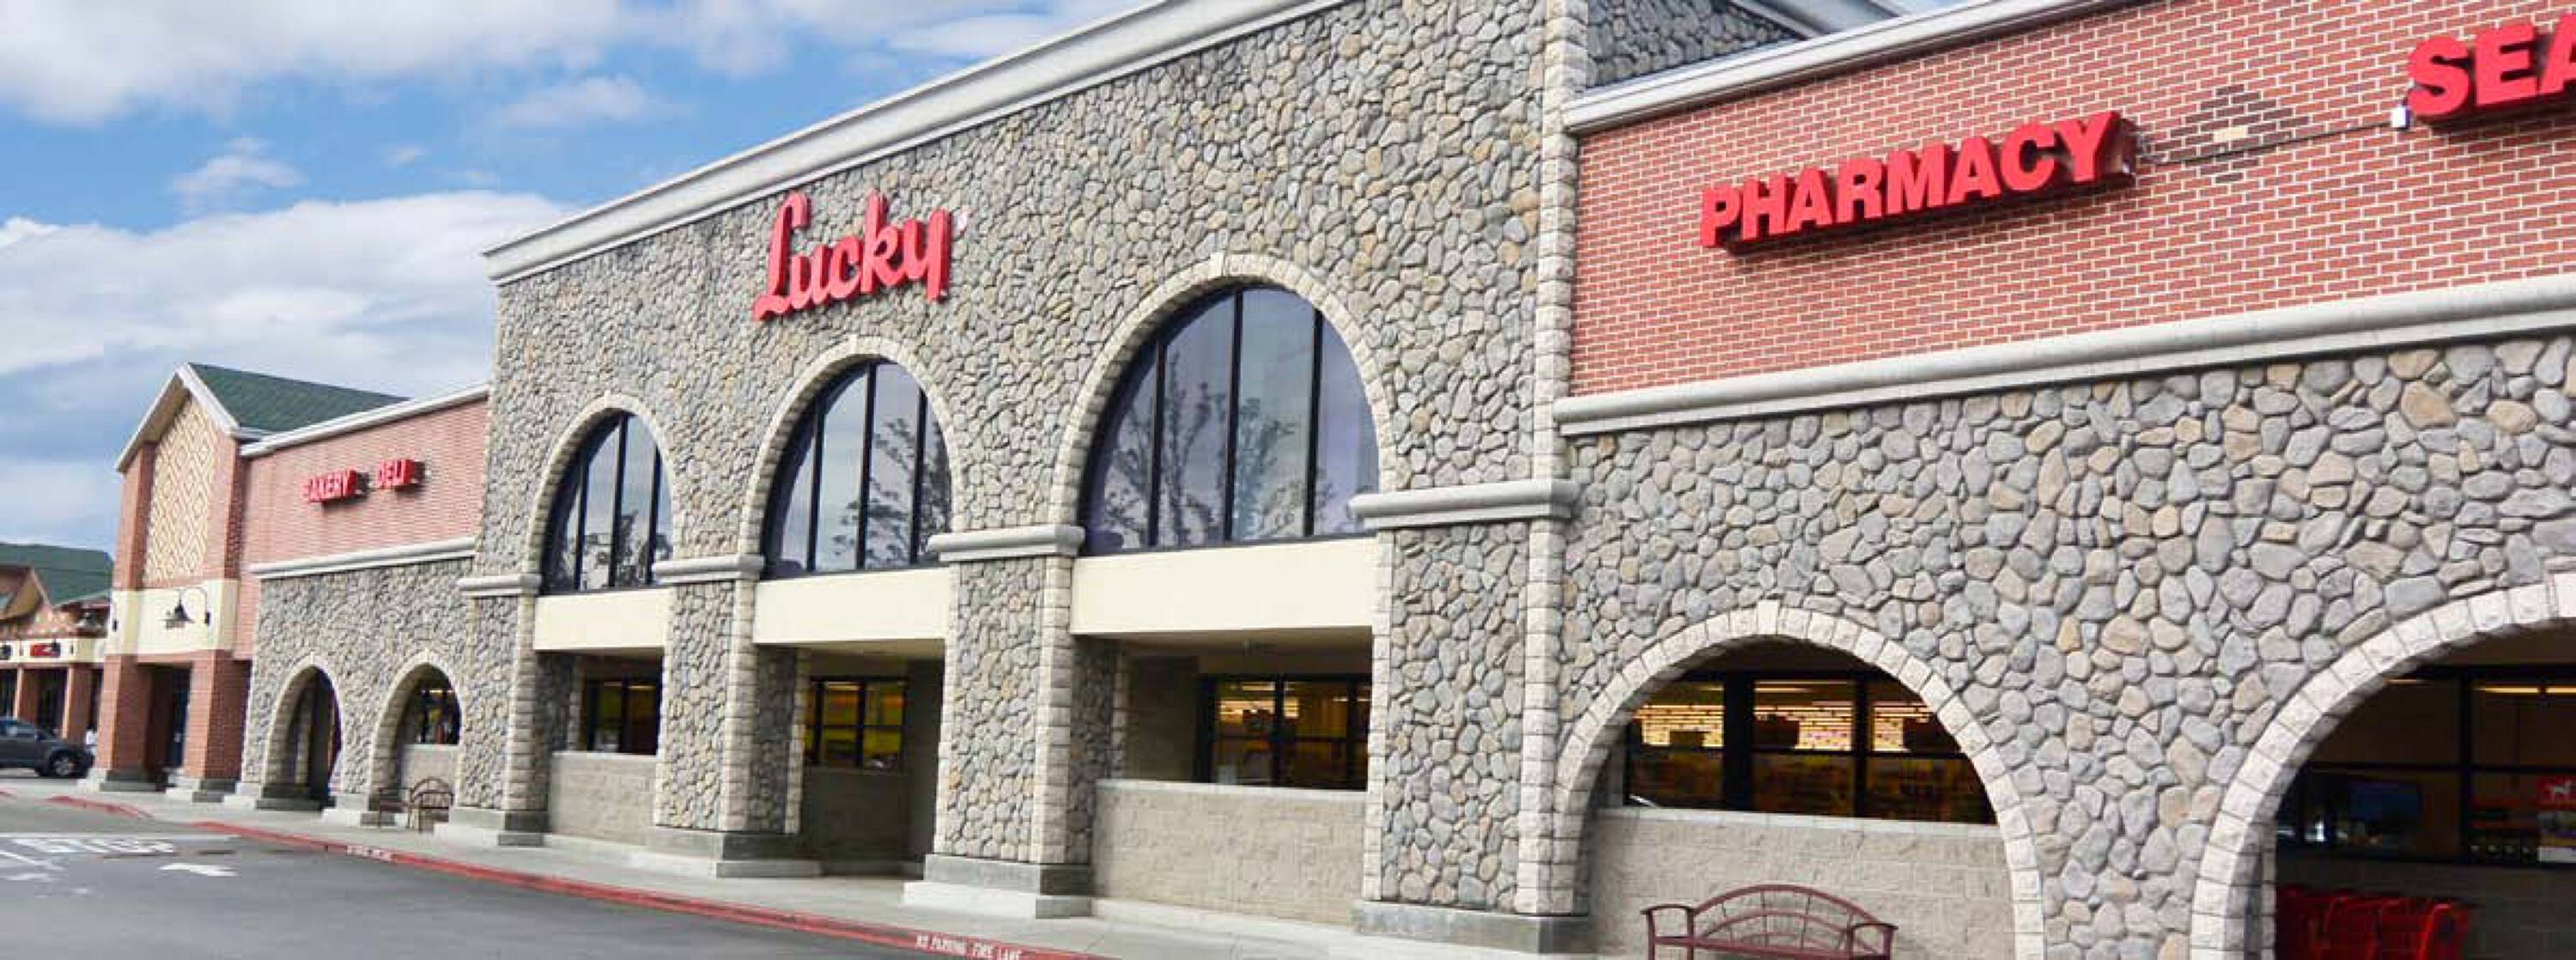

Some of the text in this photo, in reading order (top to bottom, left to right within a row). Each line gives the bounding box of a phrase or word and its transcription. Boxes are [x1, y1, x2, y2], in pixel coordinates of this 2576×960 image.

[1699, 111, 2119, 247] PHARMACY
[753, 188, 951, 321] Lucky
[376, 458, 410, 489] DELI
